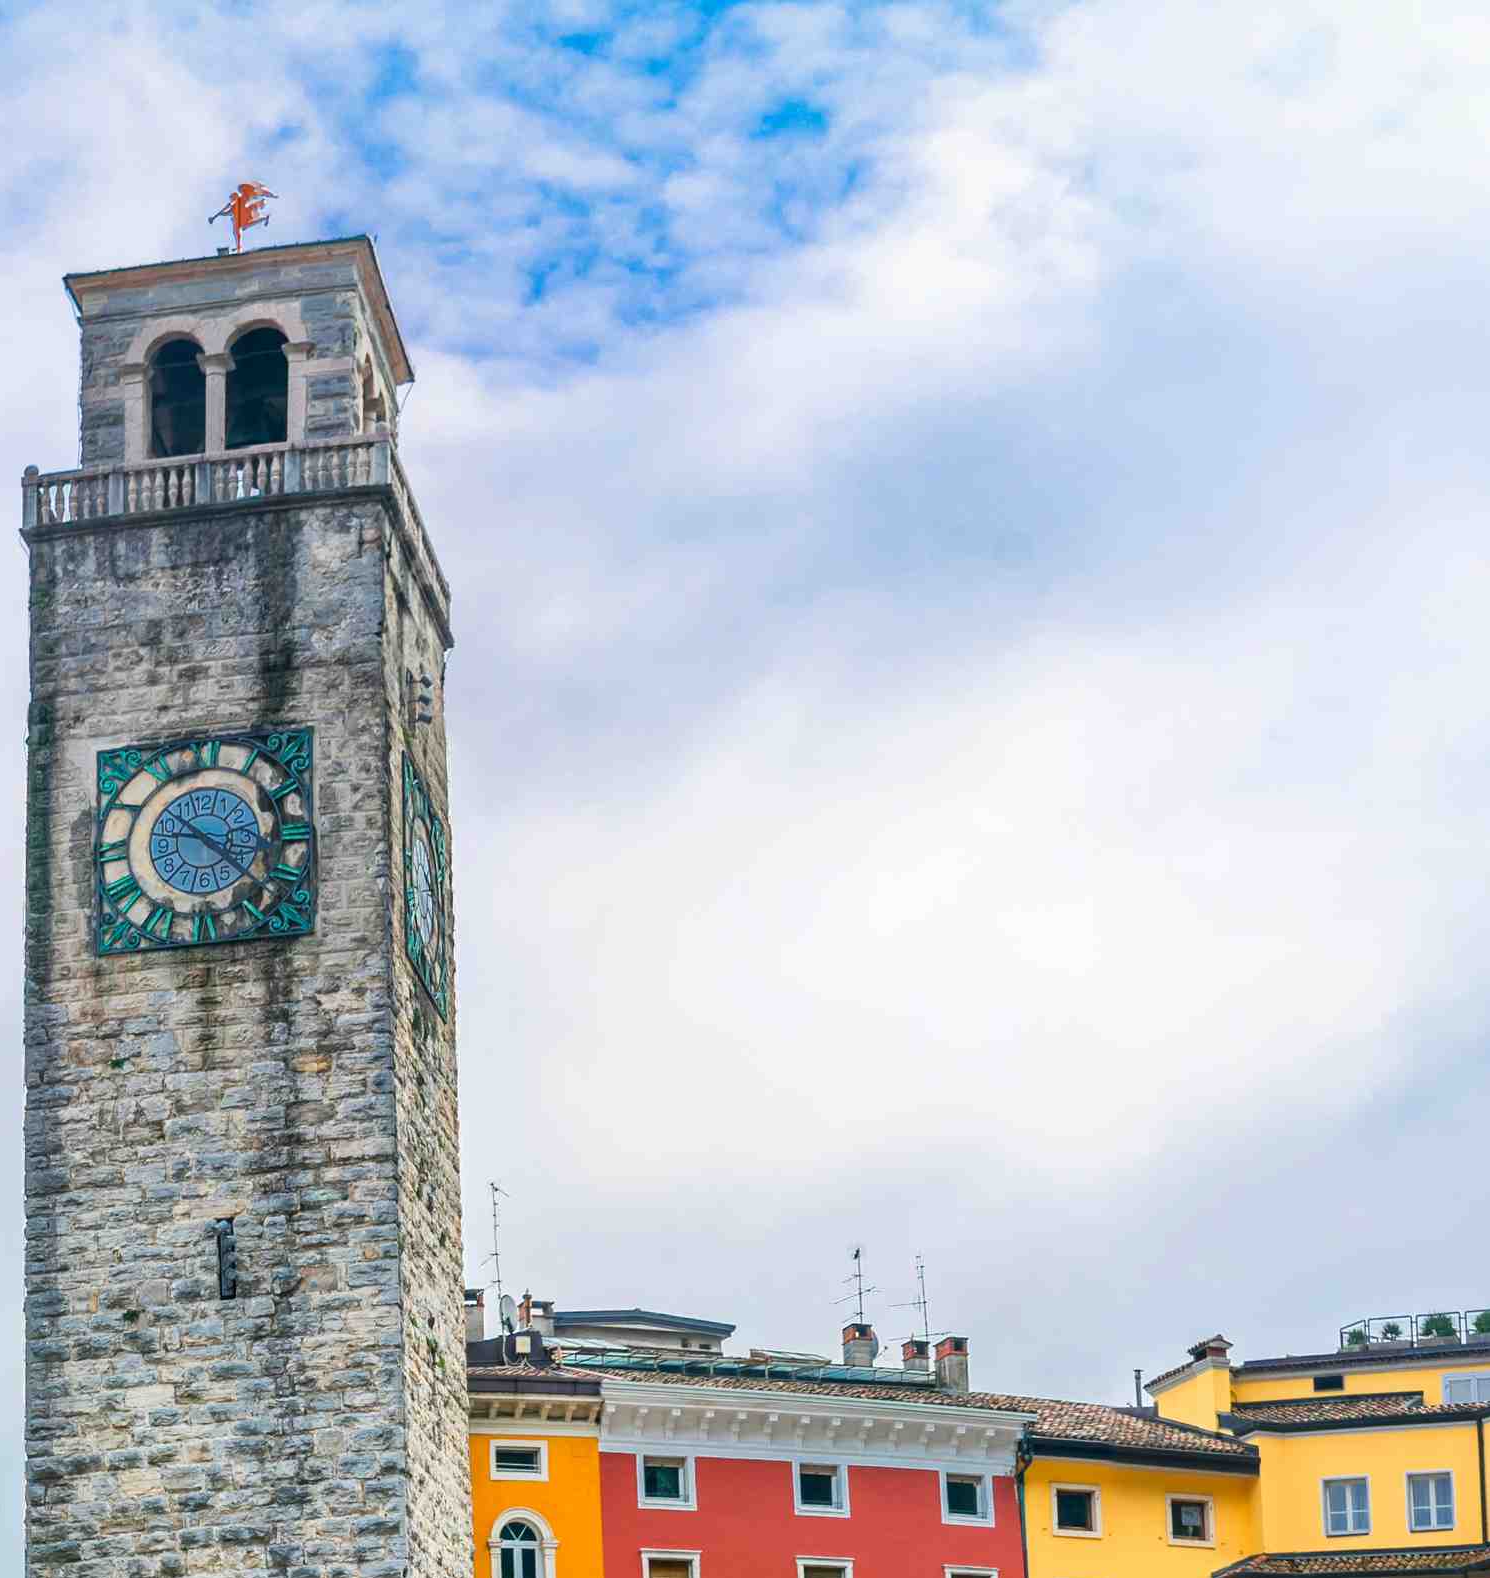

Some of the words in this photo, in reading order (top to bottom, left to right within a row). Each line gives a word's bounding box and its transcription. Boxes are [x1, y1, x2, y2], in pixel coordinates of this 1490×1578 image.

[177, 802, 190, 819] 11
[195, 795, 211, 811] 12
[220, 798, 227, 814] 1
[232, 809, 245, 824] 2
[159, 818, 175, 833] 10
[240, 829, 251, 844] 3
[157, 839, 169, 854] 9
[164, 858, 174, 873] 8
[220, 865, 230, 880] 5
[179, 870, 191, 886] 7
[200, 872, 210, 888] 6
